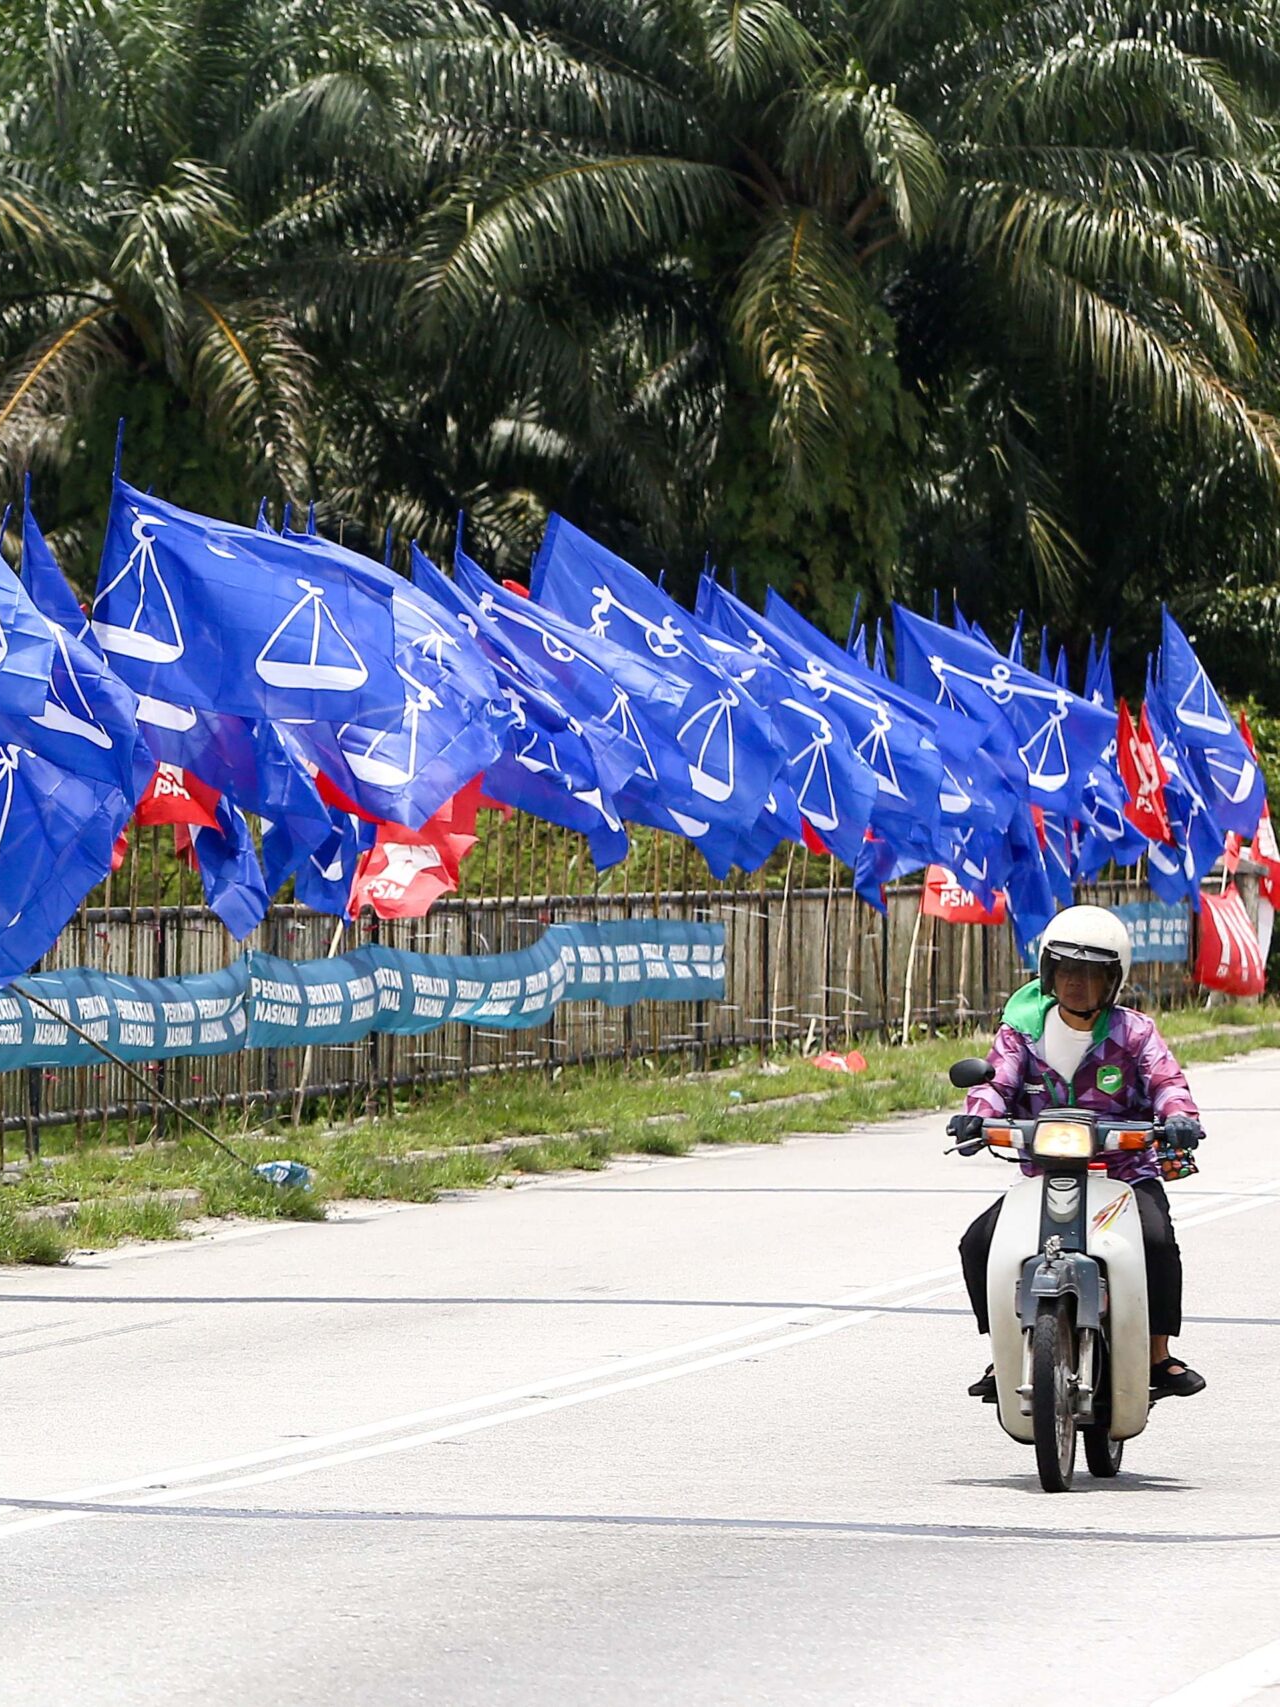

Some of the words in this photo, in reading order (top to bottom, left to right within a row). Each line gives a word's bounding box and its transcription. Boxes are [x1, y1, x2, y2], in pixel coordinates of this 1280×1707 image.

[1136, 796, 1154, 815] PS
[362, 879, 405, 900] PSM
[940, 889, 974, 907] PSM
[254, 1001, 299, 1026] NASIONAL
